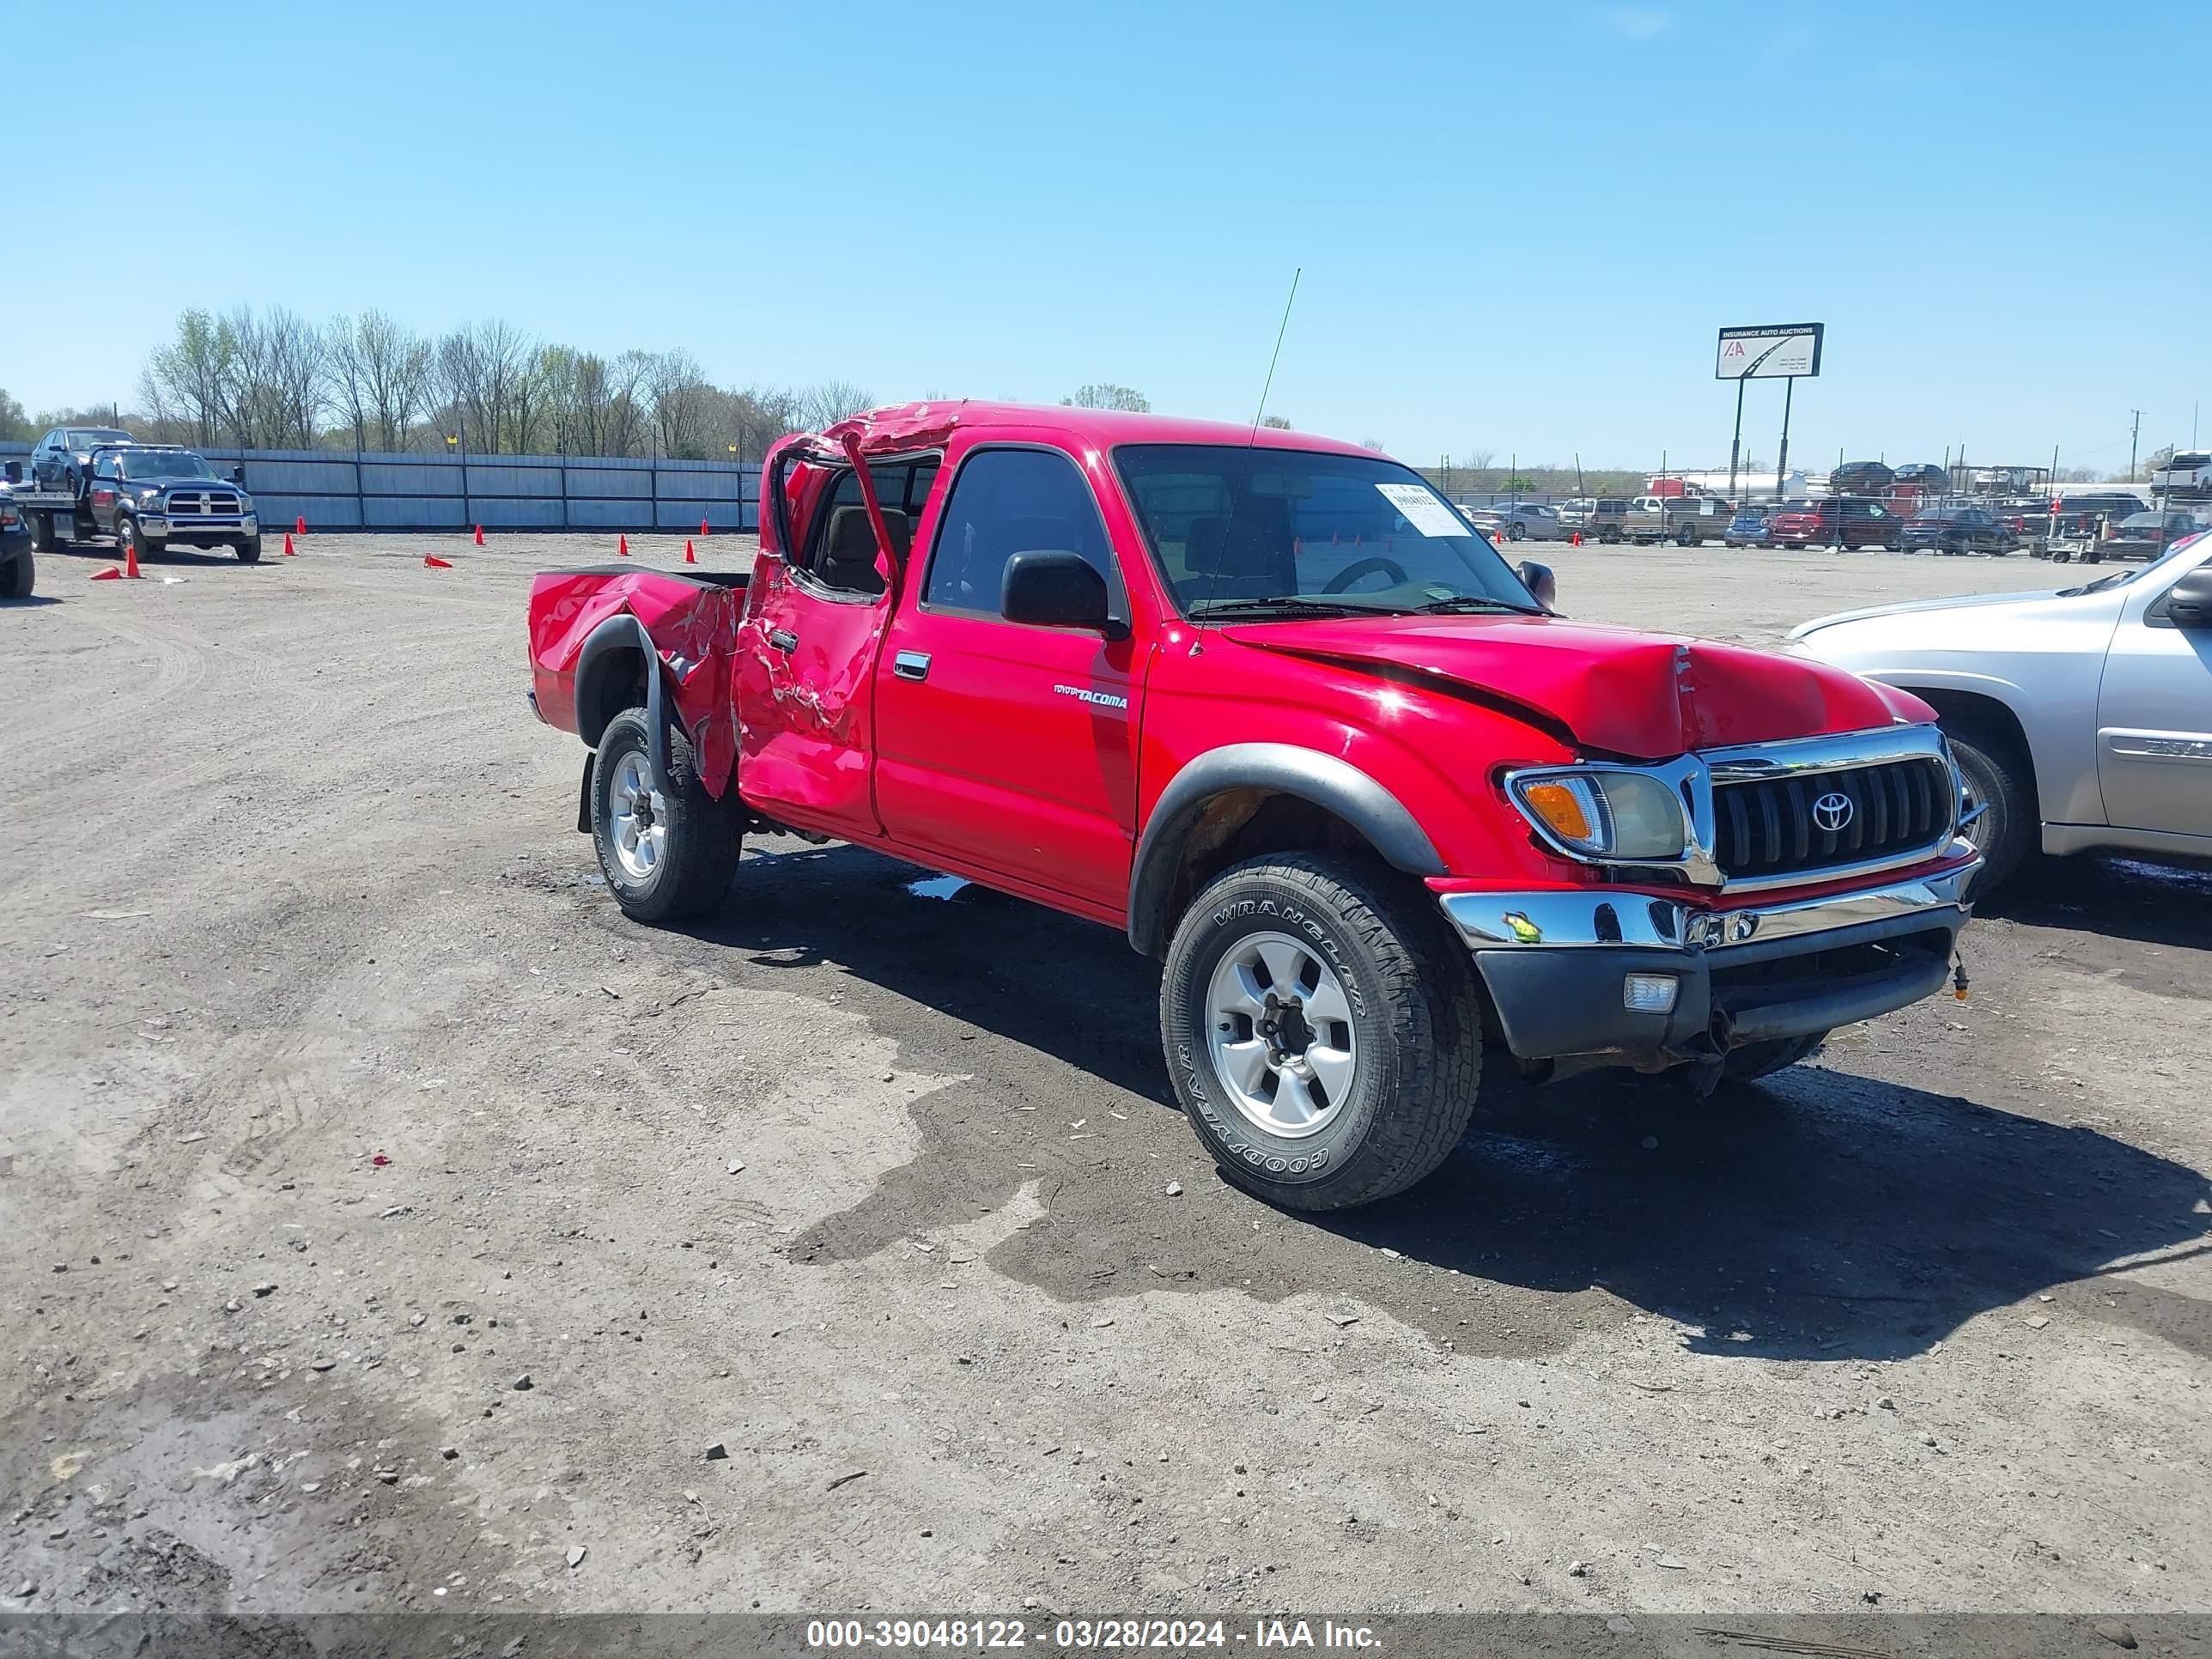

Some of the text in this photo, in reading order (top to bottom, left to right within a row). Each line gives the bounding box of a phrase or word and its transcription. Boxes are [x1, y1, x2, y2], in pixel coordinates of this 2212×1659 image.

[1723, 330, 1759, 338] INSURANCE
[1779, 327, 1813, 336] AUCTIONS
[1078, 690, 1127, 708] TACOMA
[1213, 900, 1367, 1018] WRANGLER
[1177, 1044, 1330, 1173] GOODYEAR
